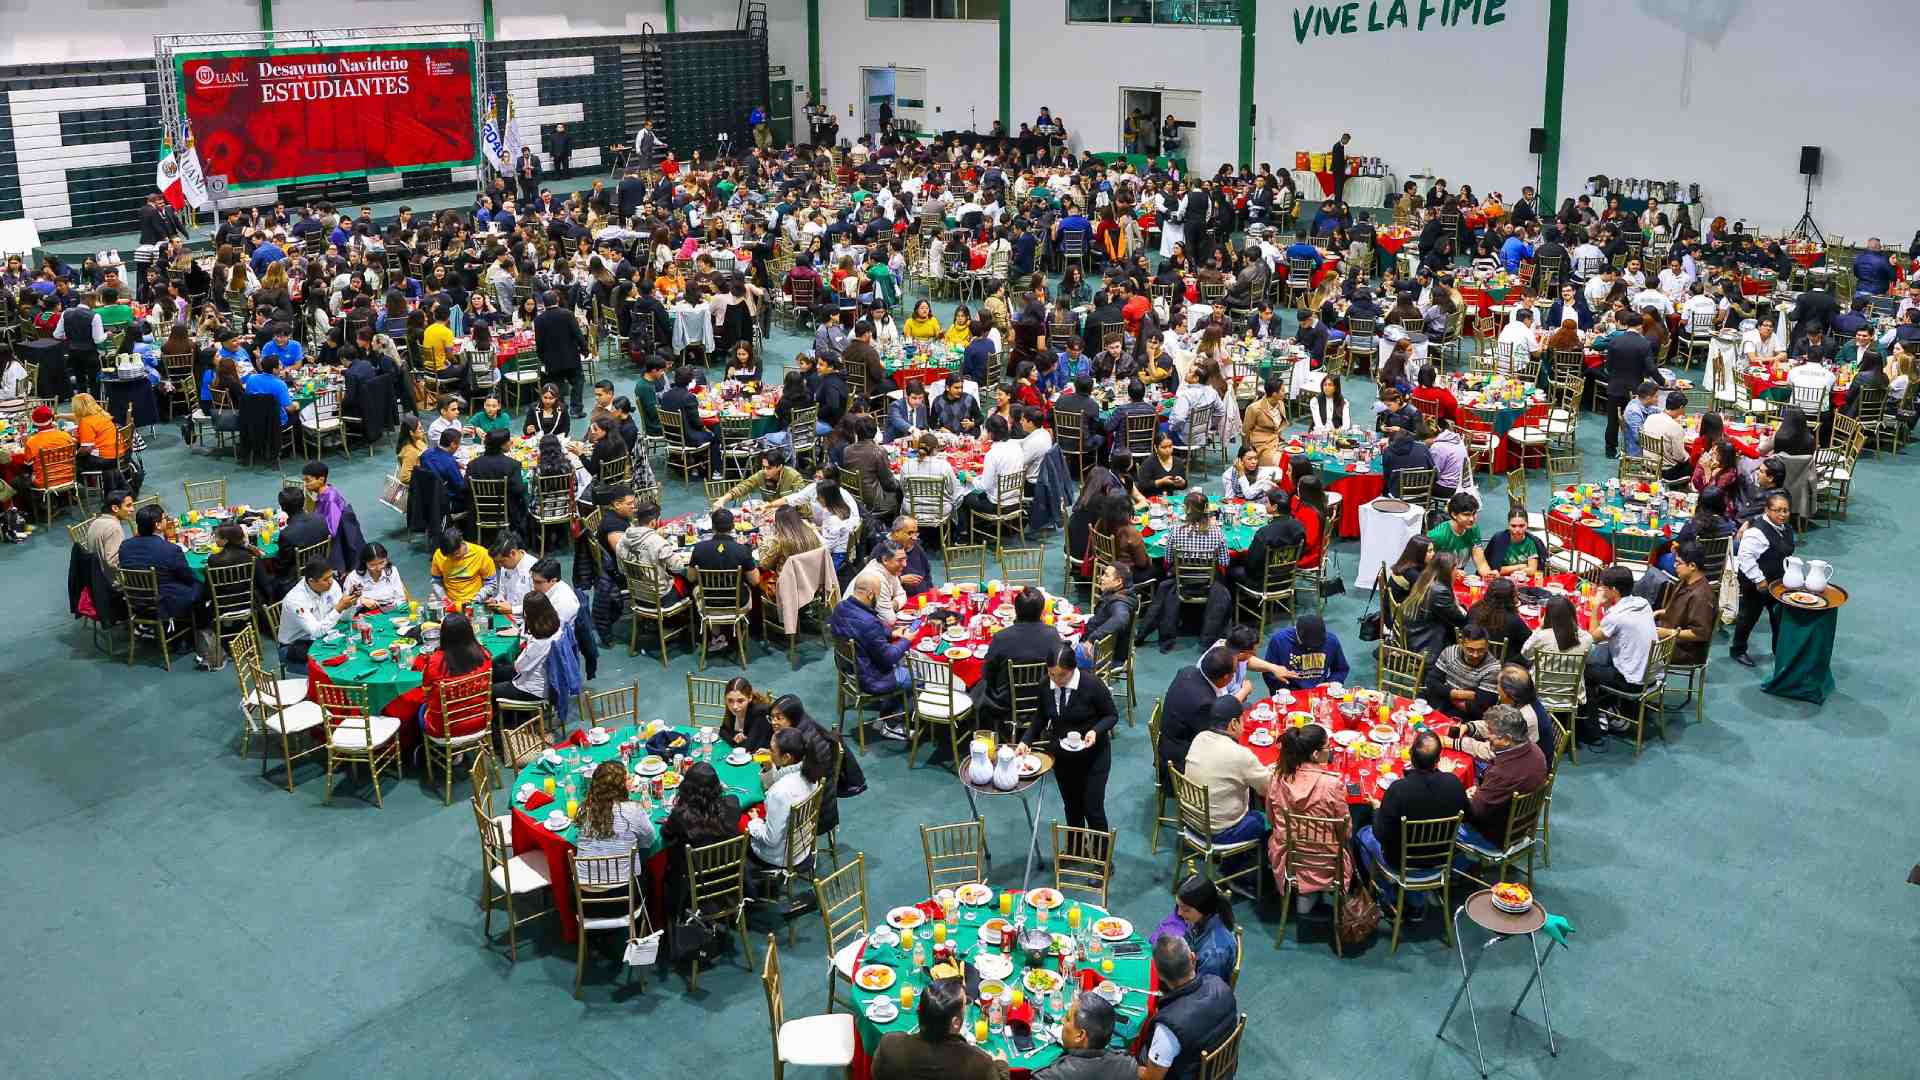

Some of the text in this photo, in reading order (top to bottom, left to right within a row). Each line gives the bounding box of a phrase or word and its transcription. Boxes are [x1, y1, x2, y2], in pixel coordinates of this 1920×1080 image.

[1294, 0, 1506, 44] VIVE LA FIME
[216, 72, 249, 84] UANL
[258, 56, 408, 79] Desayuno Navideño
[261, 76, 410, 103] ESTUDIANTES
